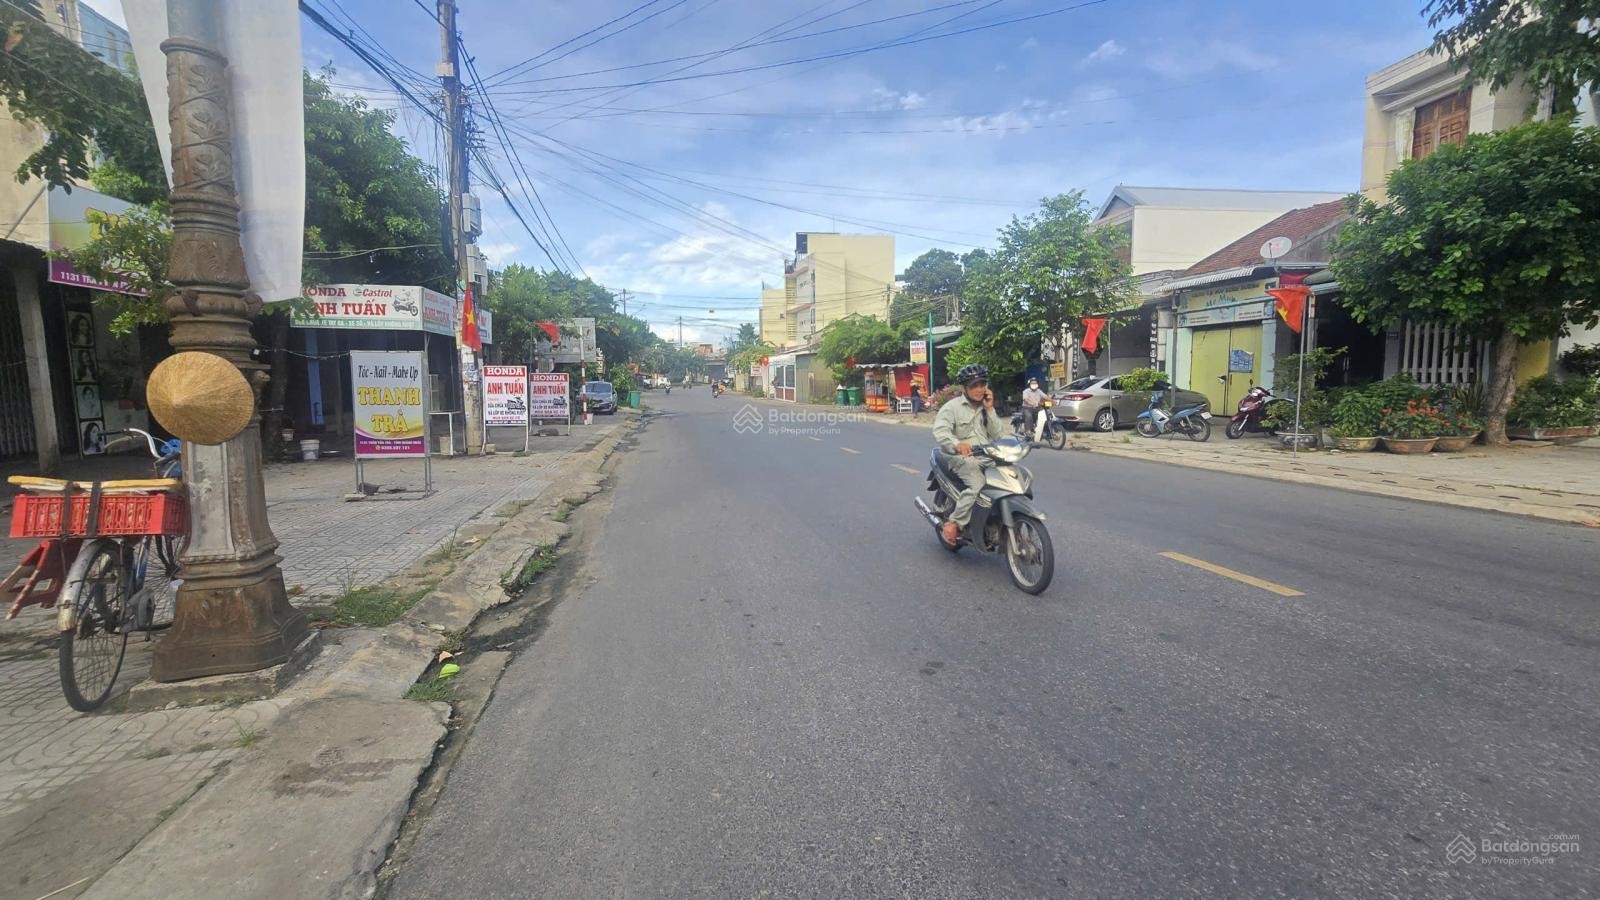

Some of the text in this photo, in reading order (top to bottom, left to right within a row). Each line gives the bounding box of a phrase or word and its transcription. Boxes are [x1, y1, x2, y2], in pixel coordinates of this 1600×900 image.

[362, 288, 392, 298] Castrol
[342, 298, 386, 316] TUẤN
[358, 365, 369, 378] Tóc
[374, 365, 387, 378] Nail
[392, 366, 408, 378] Make
[410, 366, 418, 381] Up
[488, 383, 502, 394] ANH
[533, 386, 547, 394] ANH
[357, 386, 420, 405] THANH
